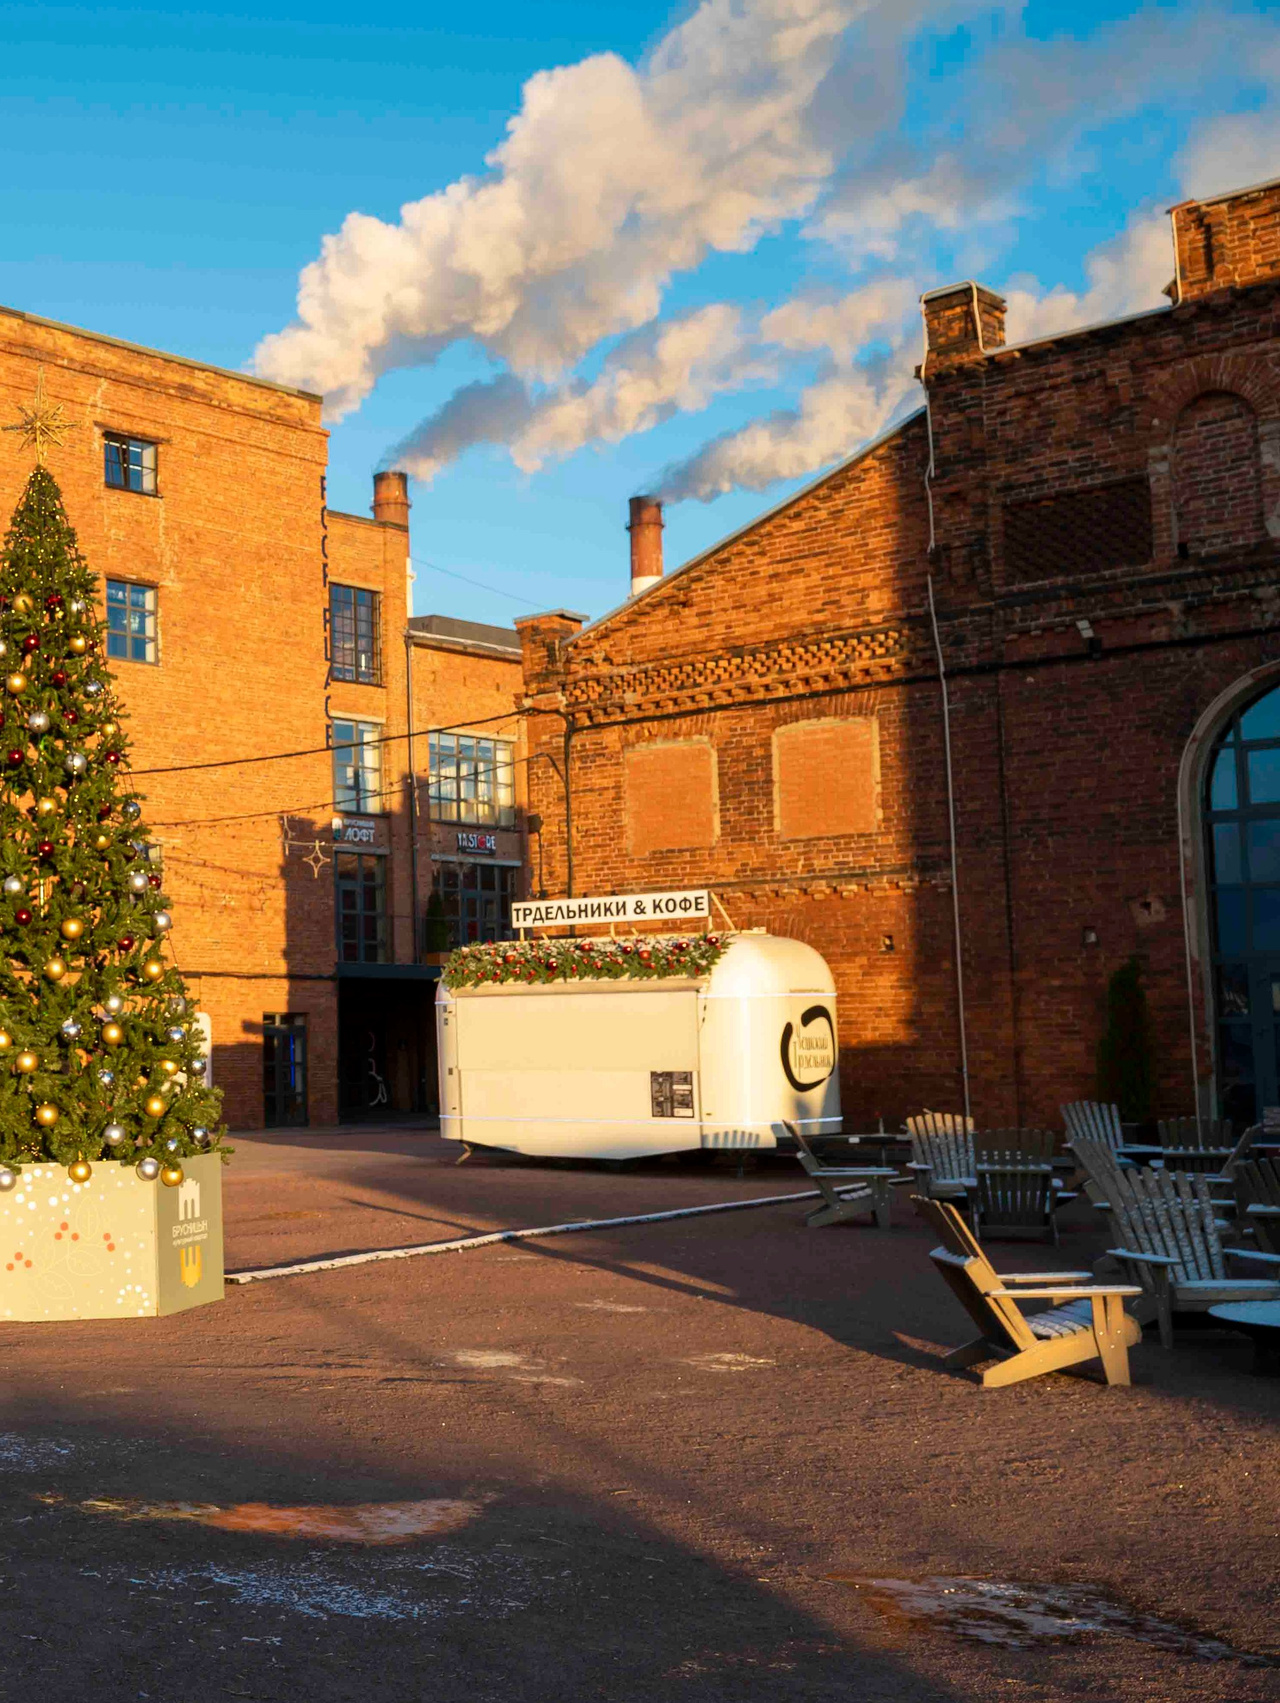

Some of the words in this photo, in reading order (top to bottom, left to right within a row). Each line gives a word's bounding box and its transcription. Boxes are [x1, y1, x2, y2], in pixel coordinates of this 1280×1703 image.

[344, 827, 375, 842] ЛОФТ
[513, 901, 627, 924] ТРДЕЛЬНИКИ
[633, 900, 647, 915] &
[653, 896, 705, 914] КОФЕ
